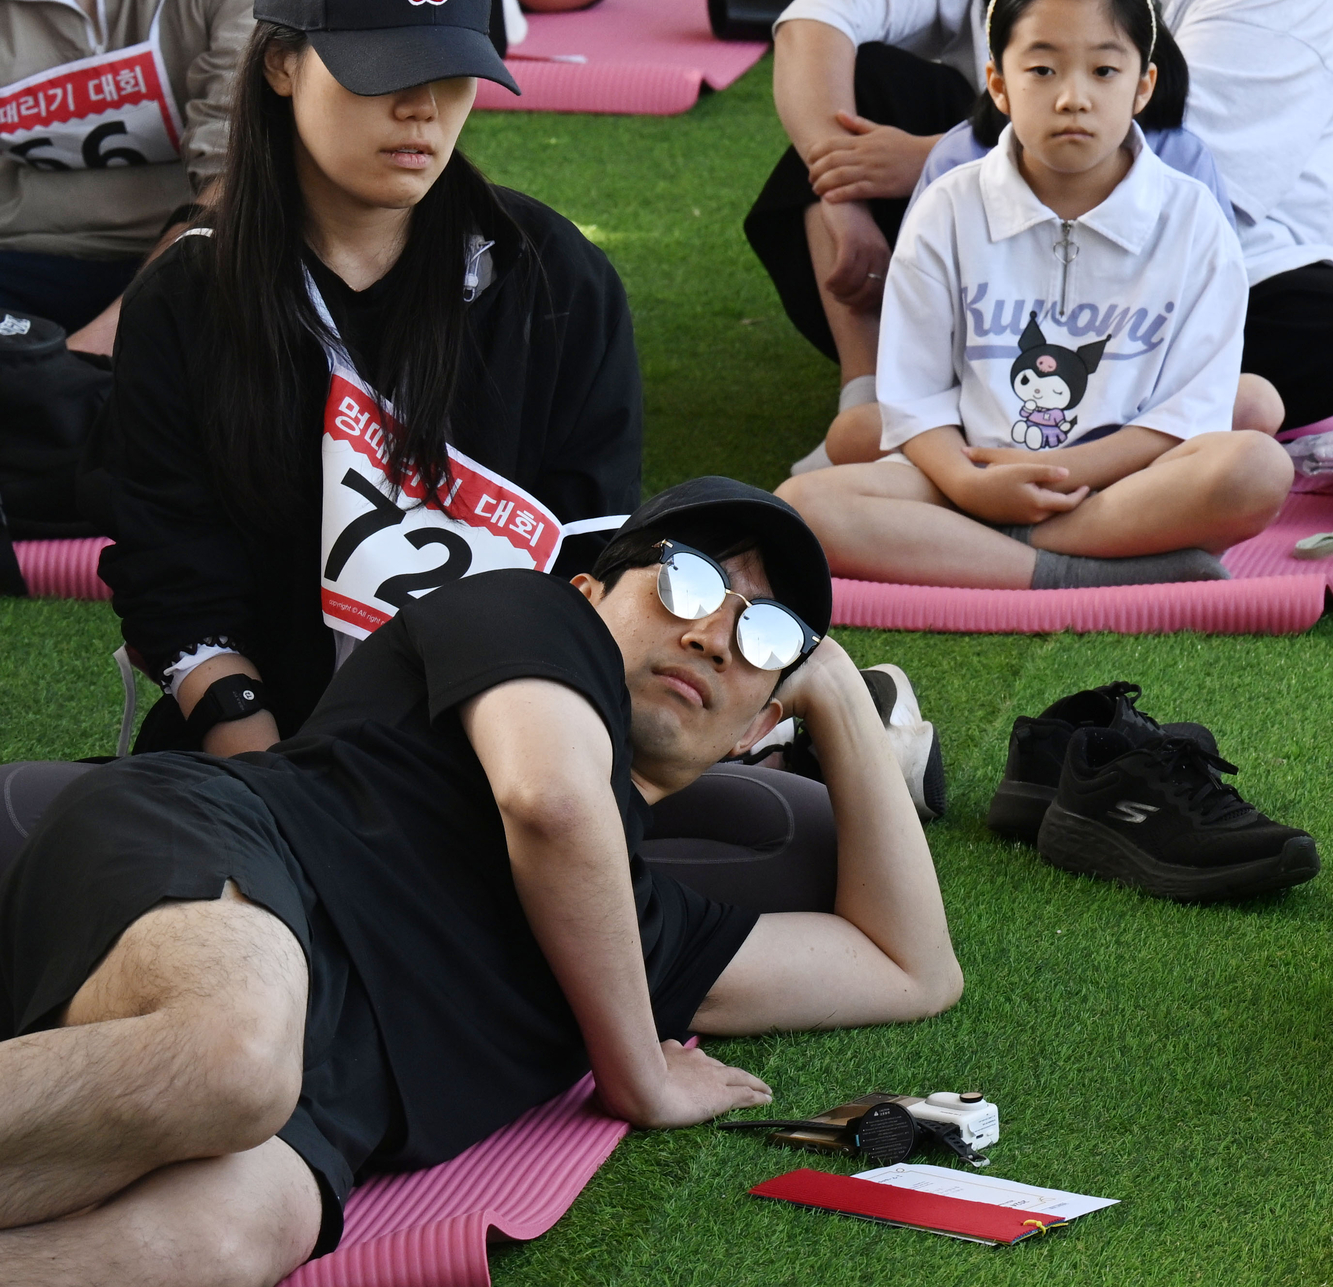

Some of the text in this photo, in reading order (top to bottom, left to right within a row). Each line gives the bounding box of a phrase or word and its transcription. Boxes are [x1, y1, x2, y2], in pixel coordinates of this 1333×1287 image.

[88, 65, 147, 102] 대회
[960, 281, 1175, 352] Kuromi
[323, 467, 473, 611] 72
[473, 492, 545, 548] 대회
[329, 599, 352, 612] copyright
[357, 609, 367, 617] All
[366, 614, 381, 625] right
